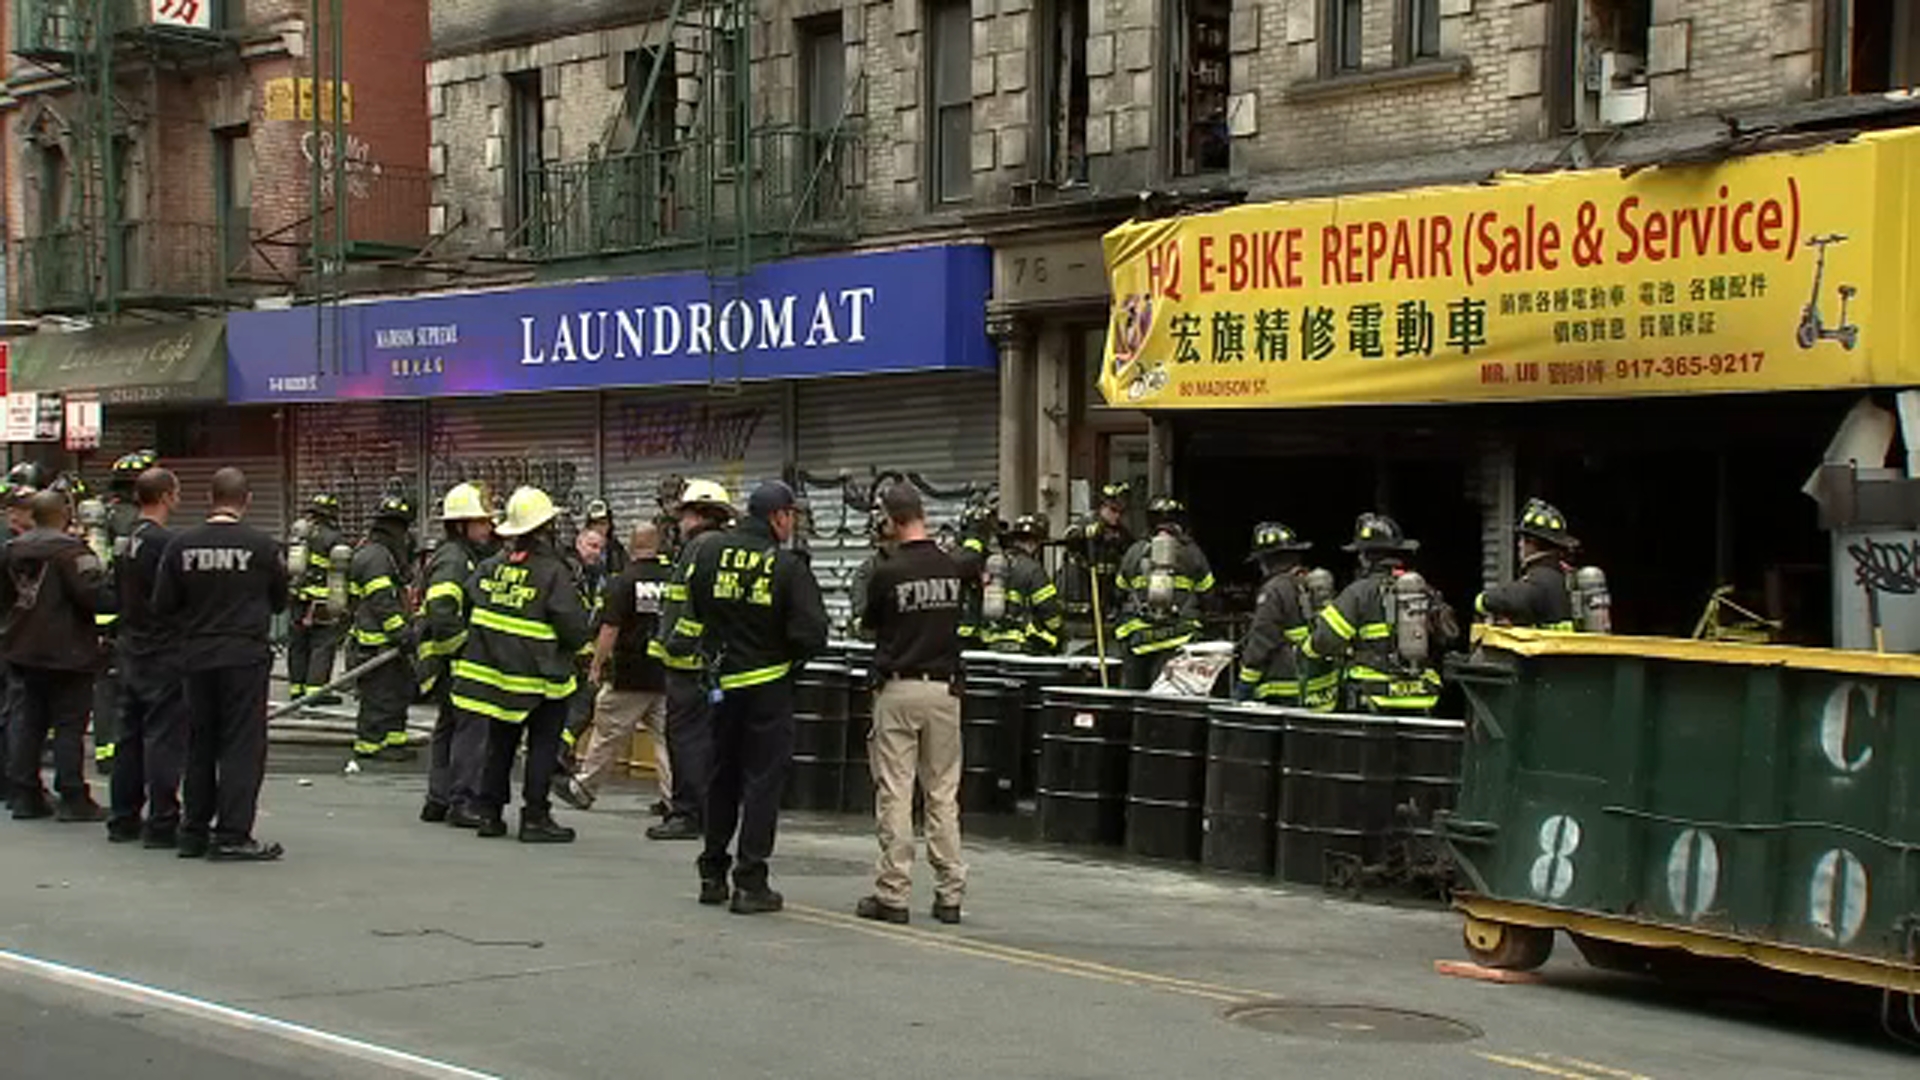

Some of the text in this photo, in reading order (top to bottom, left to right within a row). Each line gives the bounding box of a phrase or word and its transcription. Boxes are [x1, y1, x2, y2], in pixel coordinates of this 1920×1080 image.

[1199, 228, 1303, 293] E-BIKE
[1322, 215, 1453, 286] REPAIR
[1463, 205, 1562, 286] (Sale
[1572, 200, 1603, 268] &
[1616, 176, 1800, 264] Service)
[520, 287, 875, 365] LAUNDROMAT
[1169, 297, 1487, 364] 宏旗精修電動車
[1195, 380, 1251, 397] MADISON
[1615, 350, 1765, 379] 917-365-9217
[182, 548, 253, 571] FDNY
[895, 578, 961, 613] FDNY
[1821, 681, 1879, 772] C
